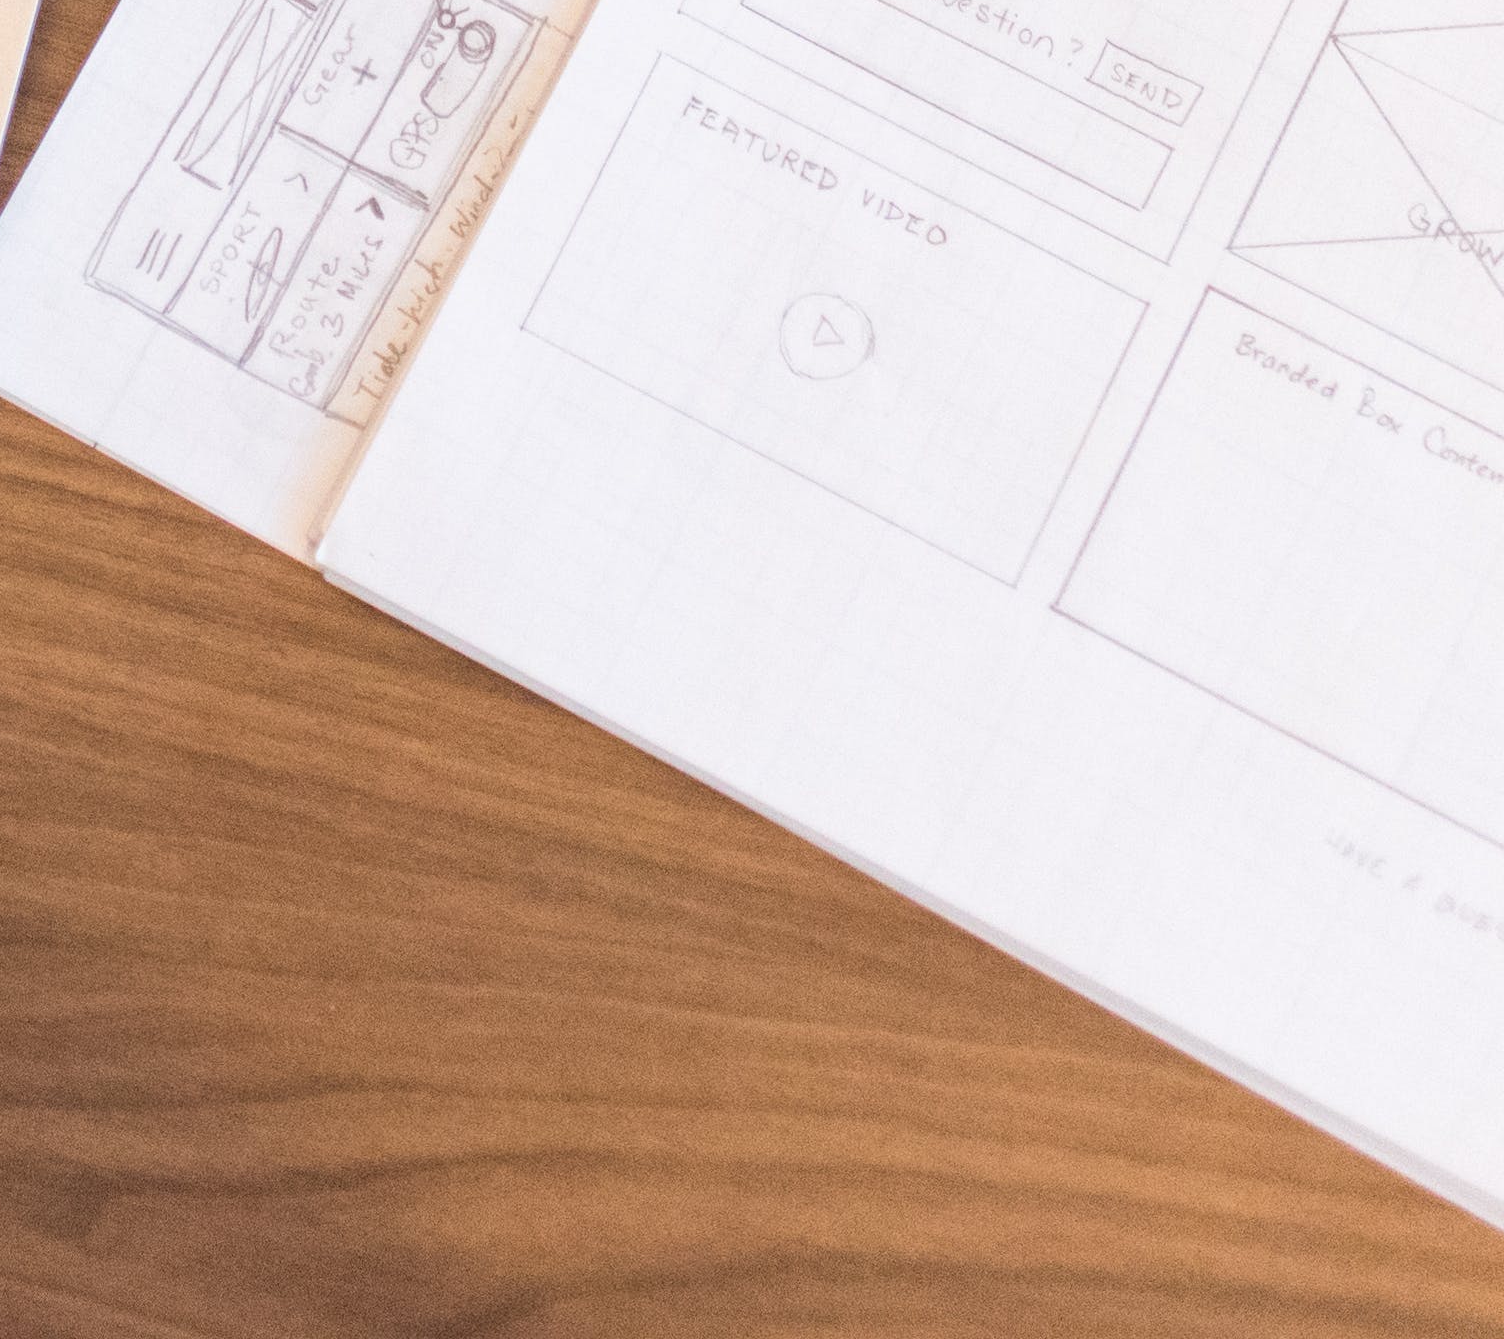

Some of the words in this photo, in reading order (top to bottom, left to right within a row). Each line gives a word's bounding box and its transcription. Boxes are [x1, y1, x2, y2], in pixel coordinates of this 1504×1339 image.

[302, 22, 356, 107] Gear
[1106, 60, 1187, 116] SEND
[681, 94, 839, 192] FEATURED
[861, 188, 950, 247] VIDEO
[198, 199, 262, 295] SPORT
[269, 243, 340, 363] Route
[1234, 331, 1339, 400] Branded
[1355, 385, 1403, 435] Box
